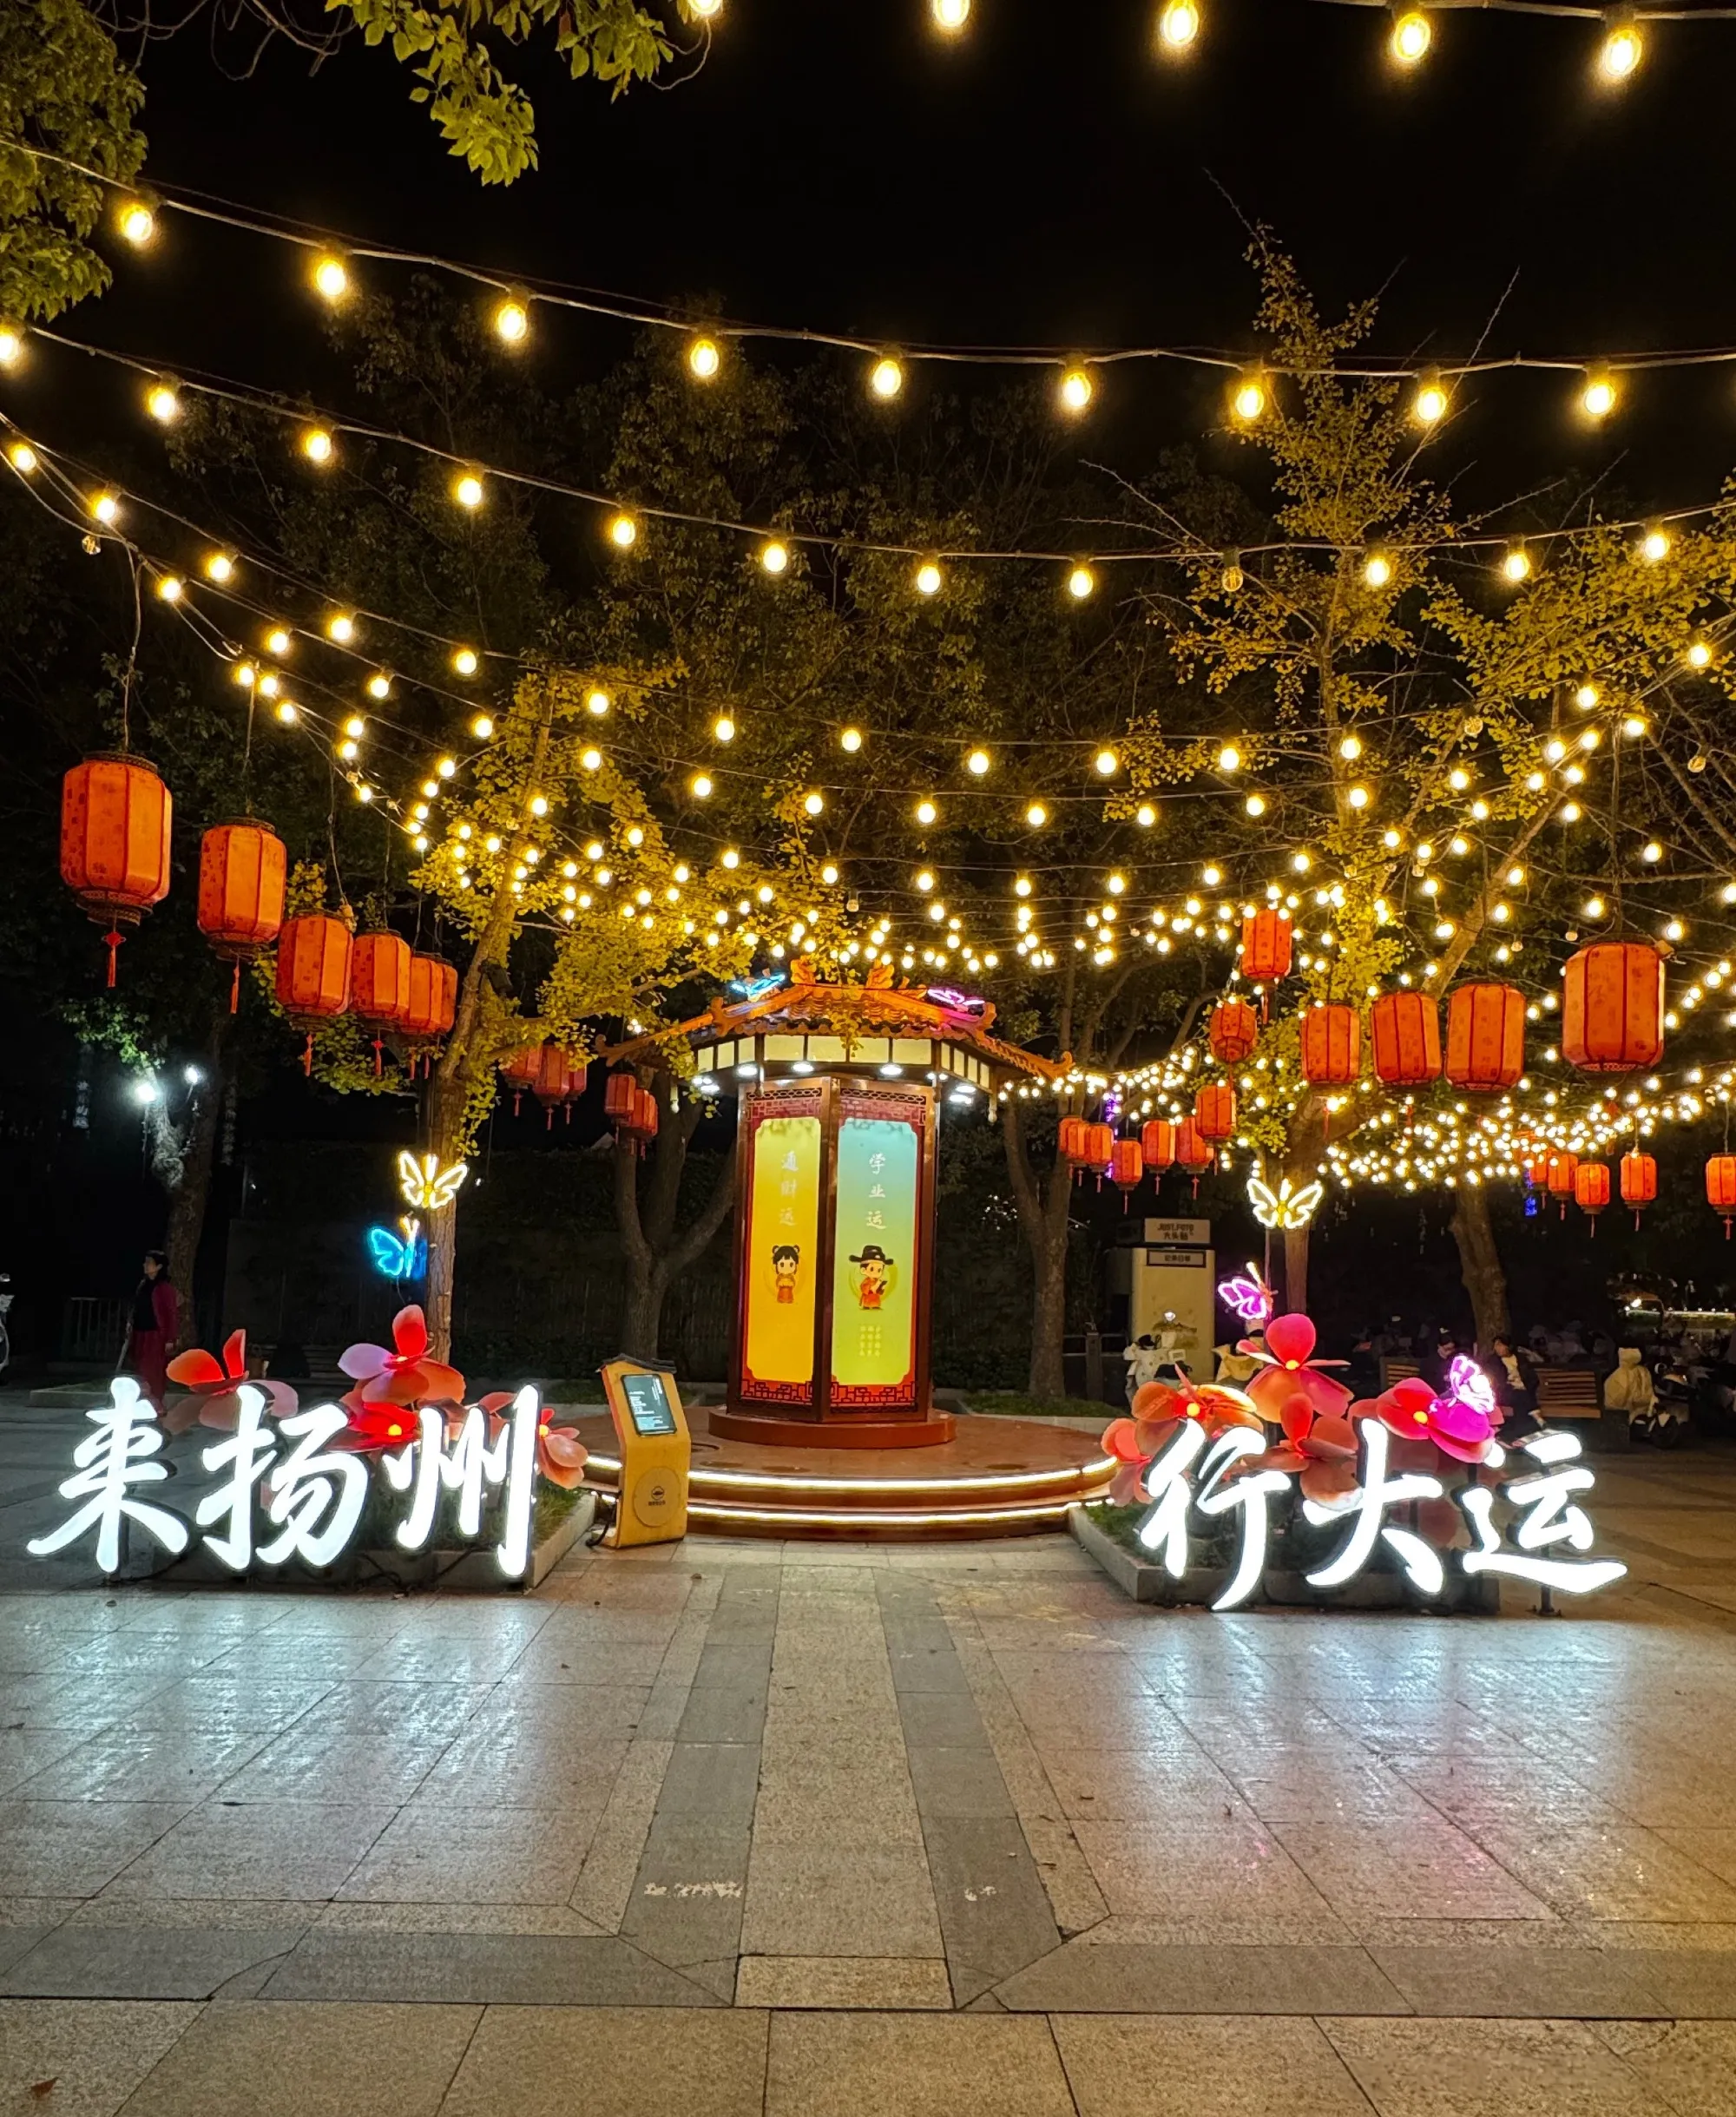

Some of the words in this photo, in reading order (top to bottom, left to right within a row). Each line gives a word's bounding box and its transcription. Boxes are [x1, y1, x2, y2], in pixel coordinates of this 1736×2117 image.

[865, 1152, 887, 1230] 学业运
[26, 1376, 541, 1577] 来扬州
[1140, 1418, 1628, 1610] 行大运
